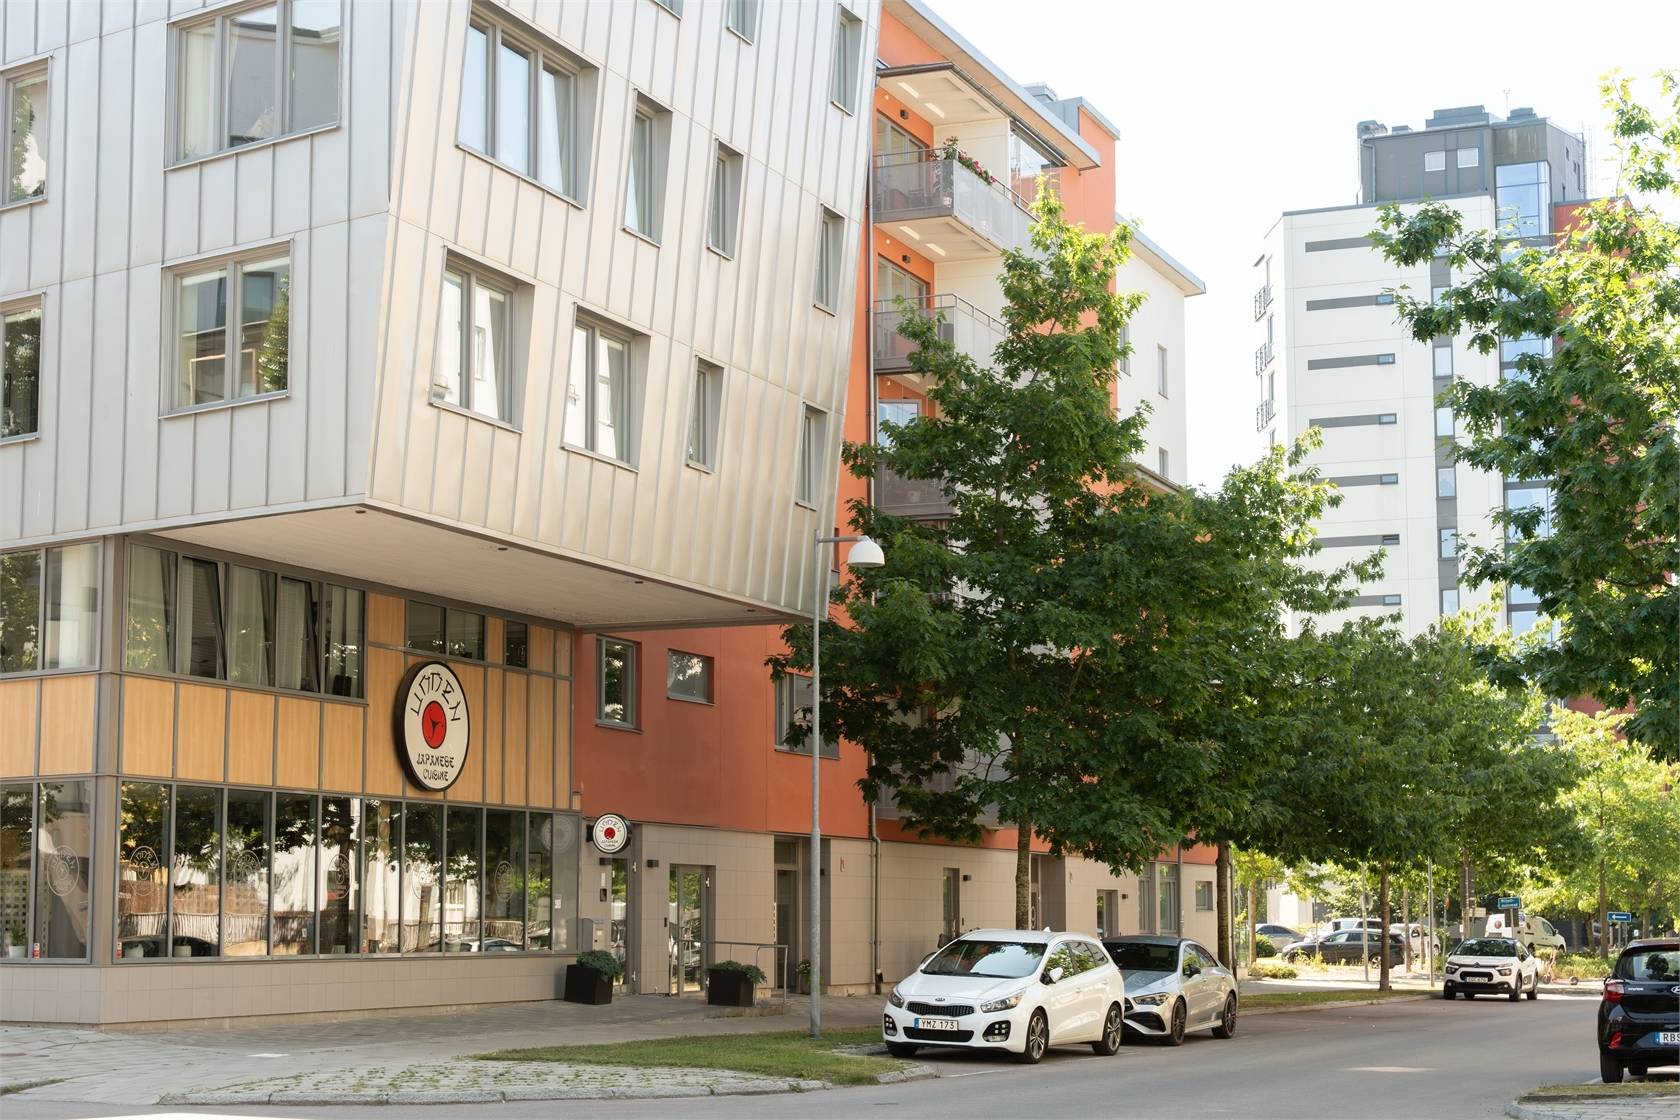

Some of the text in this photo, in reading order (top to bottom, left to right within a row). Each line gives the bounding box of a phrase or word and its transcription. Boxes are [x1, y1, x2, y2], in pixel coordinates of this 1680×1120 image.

[416, 753, 455, 768] JAPANESE
[422, 769, 449, 781] CUISINE
[921, 1019, 955, 1030] YMZ 173
